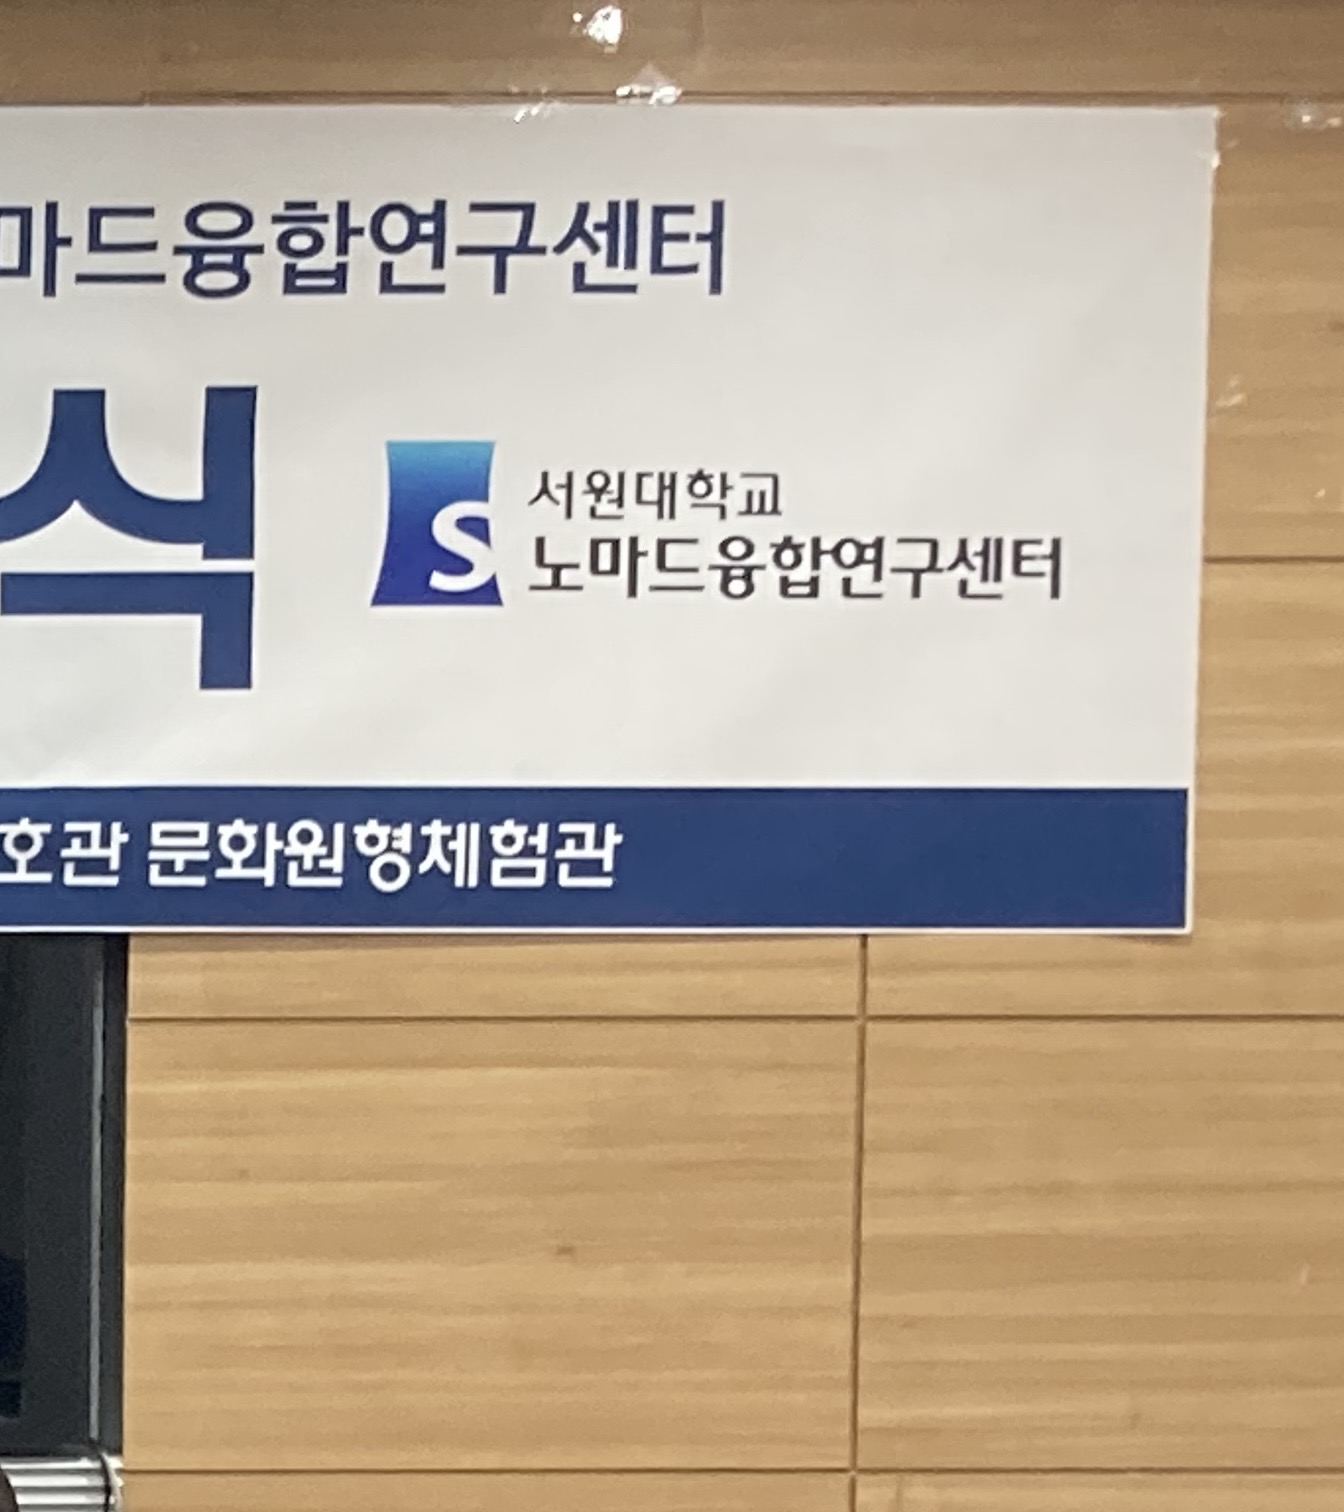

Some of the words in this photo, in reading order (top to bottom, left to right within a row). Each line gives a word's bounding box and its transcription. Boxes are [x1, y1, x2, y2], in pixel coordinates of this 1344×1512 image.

[528, 468, 782, 520] 서원대학교
[528, 535, 1063, 600] 노마드융합연구센터
[147, 818, 624, 893] 문화원형체험관
